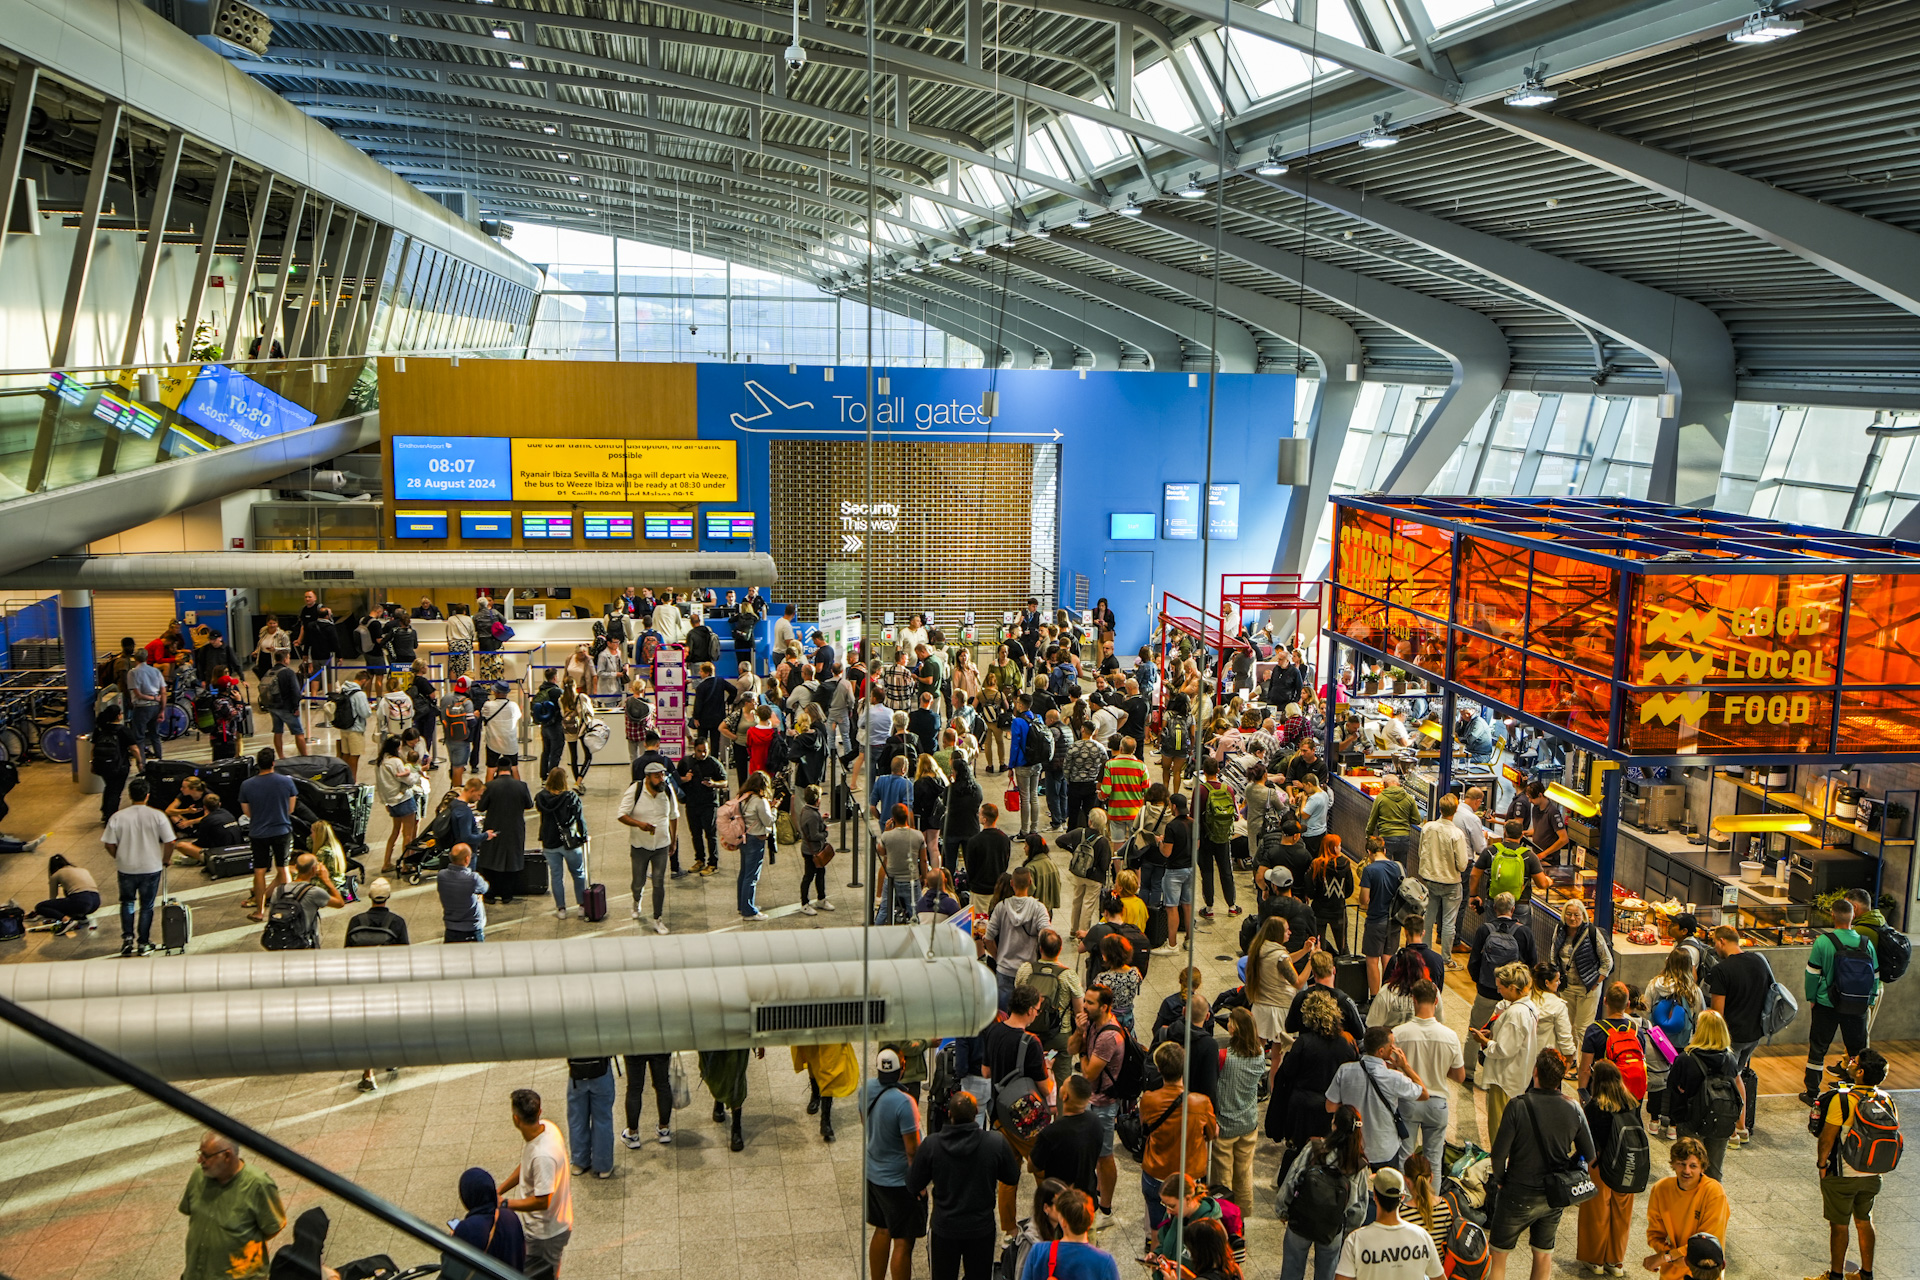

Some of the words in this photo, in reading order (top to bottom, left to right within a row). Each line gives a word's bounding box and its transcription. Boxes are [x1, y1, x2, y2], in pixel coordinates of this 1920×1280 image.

[832, 395, 866, 423] To
[876, 396, 904, 423] all
[915, 399, 992, 430] gates
[608, 452, 642, 460] possible
[428, 459, 475, 473] 08:07
[520, 471, 550, 479] Ryanair
[407, 478, 421, 488] 28
[424, 478, 465, 490] August
[468, 479, 496, 488] 2024
[840, 501, 900, 517] Security
[840, 517, 867, 531] This
[870, 520, 898, 533] way
[1731, 606, 1819, 636] GOOD
[1727, 650, 1831, 679] LOCAL
[1724, 695, 1810, 724] FOOD
[1626, 1152, 1636, 1176] PUMA
[1571, 1180, 1595, 1196] adida
[1361, 1244, 1429, 1265] OLAVOGA
